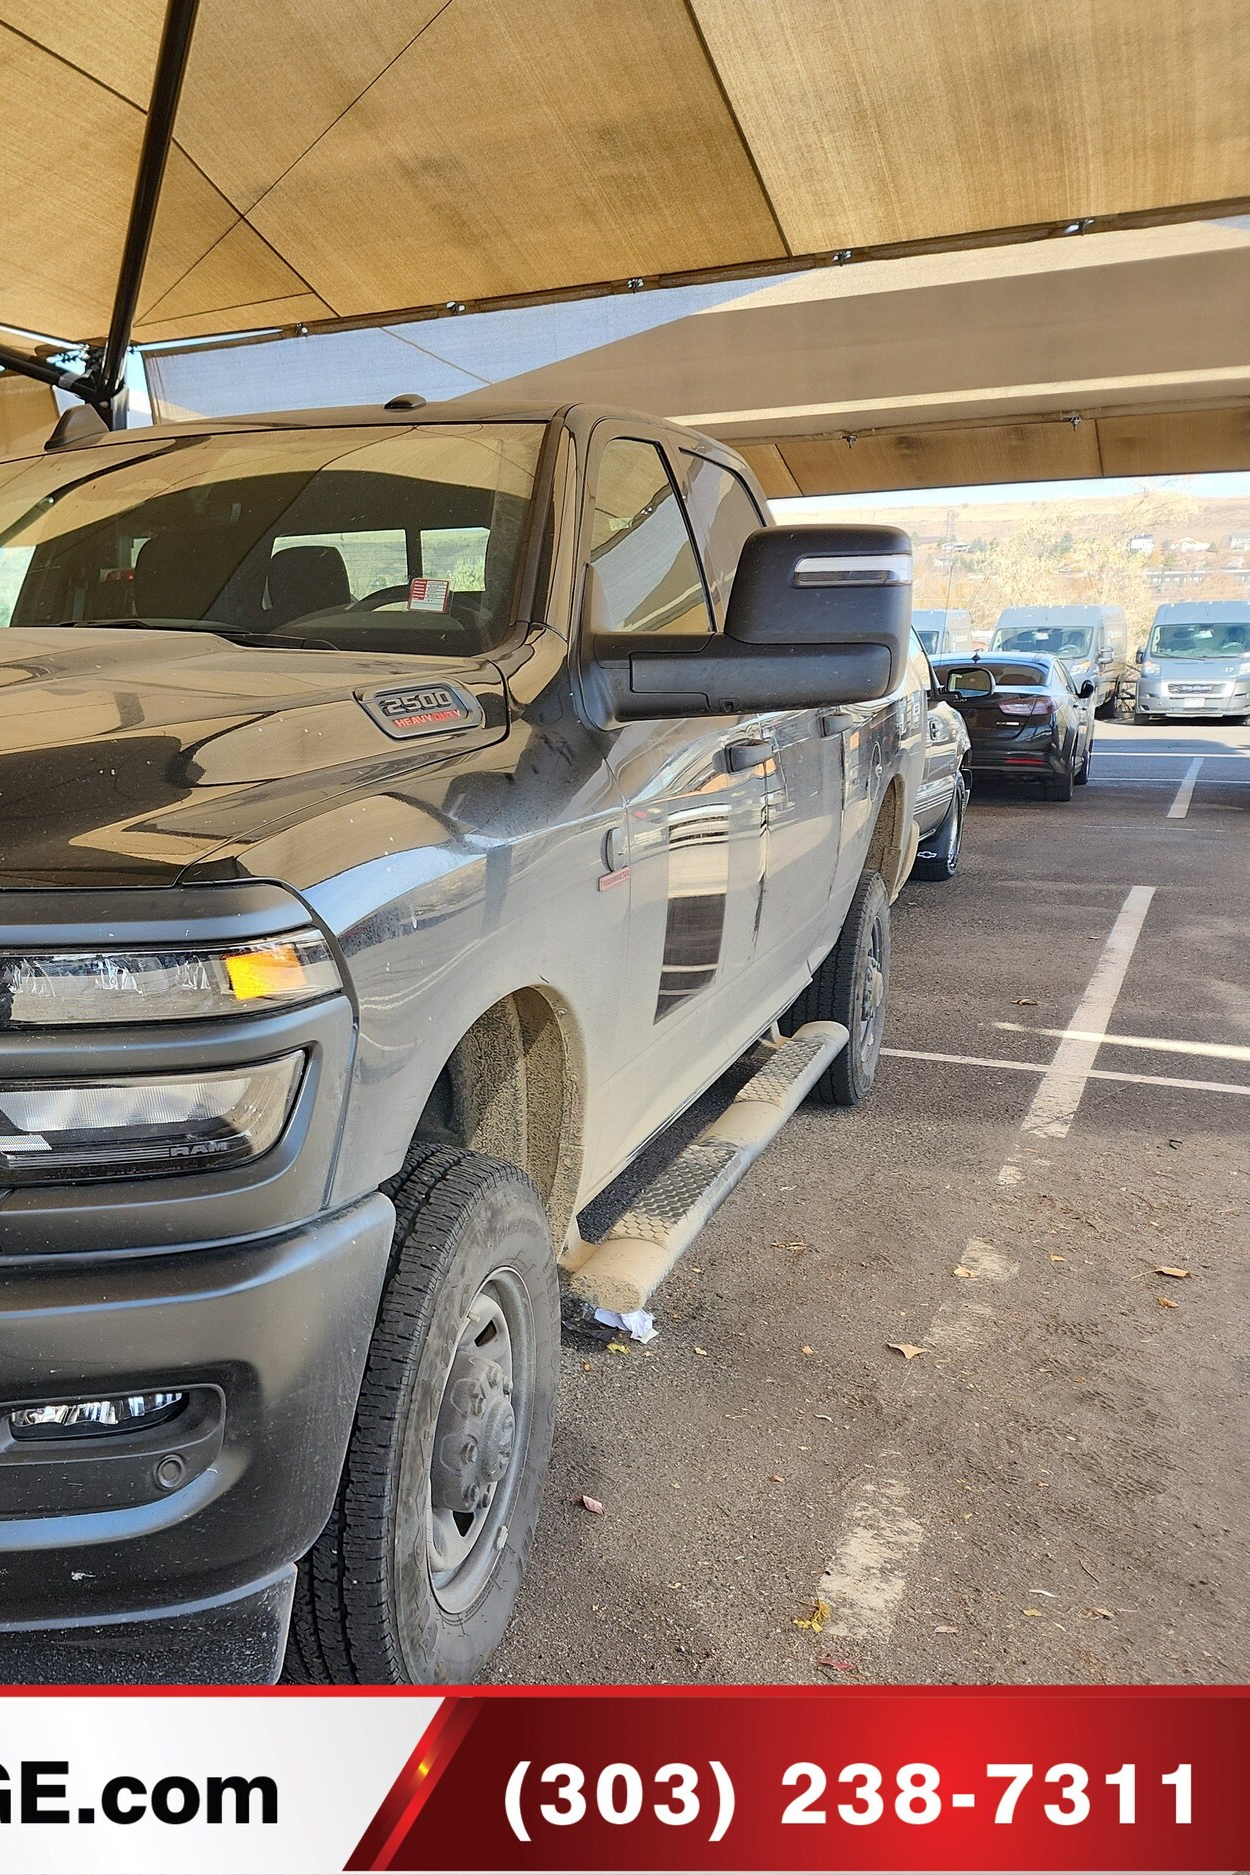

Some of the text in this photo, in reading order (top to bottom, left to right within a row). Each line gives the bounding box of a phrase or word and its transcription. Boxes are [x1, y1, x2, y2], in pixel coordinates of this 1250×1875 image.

[380, 691, 453, 716] 2500
[394, 709, 461, 728] HEAVY DUTY
[170, 1141, 228, 1157] RAM
